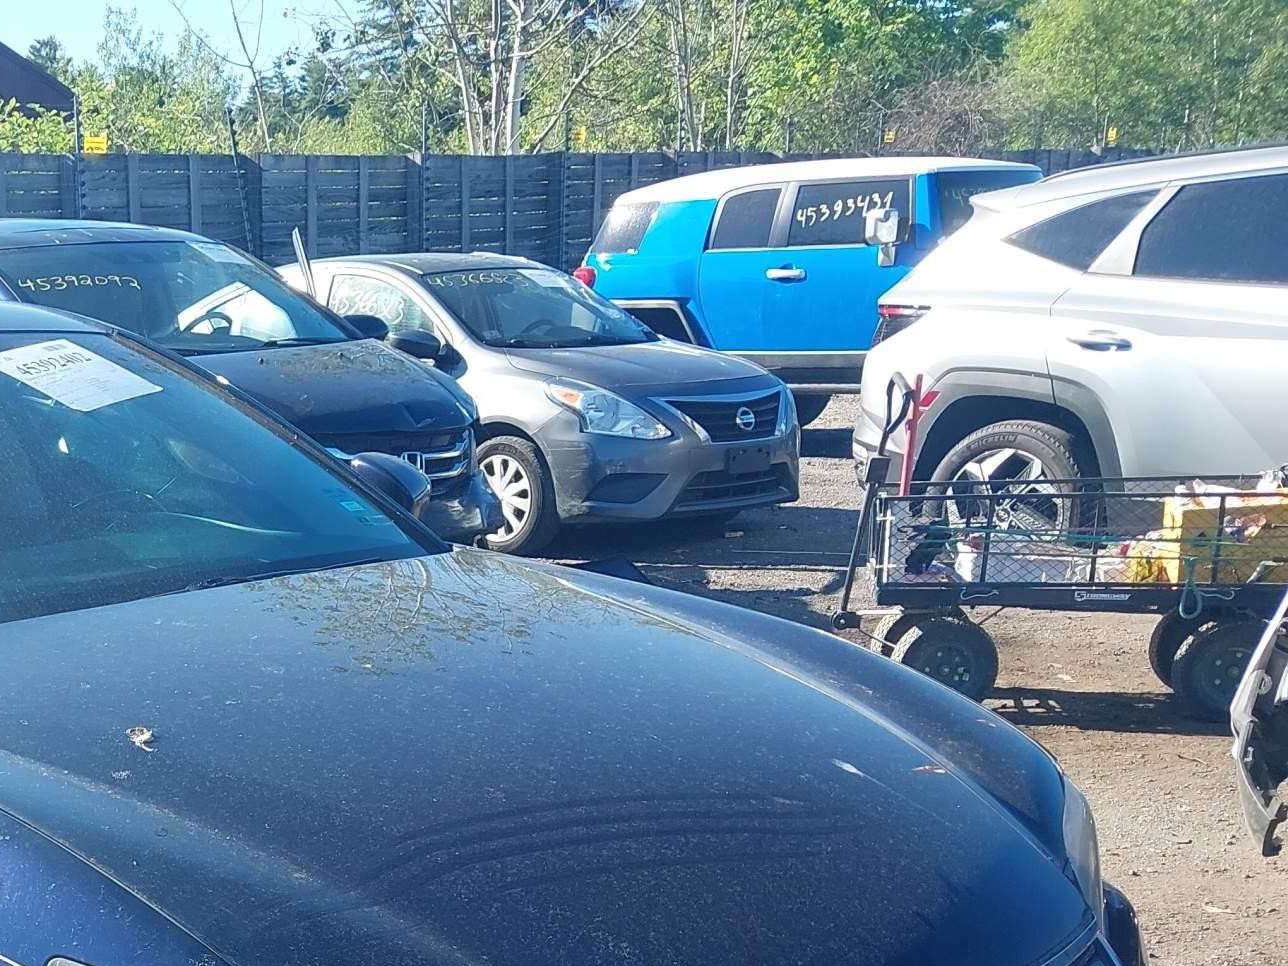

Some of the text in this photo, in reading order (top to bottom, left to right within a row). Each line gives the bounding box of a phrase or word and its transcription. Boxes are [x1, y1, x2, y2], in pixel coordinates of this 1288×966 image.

[796, 191, 894, 228] 45393431
[18, 274, 142, 291] 45392092
[15, 351, 93, 377] 45392402
